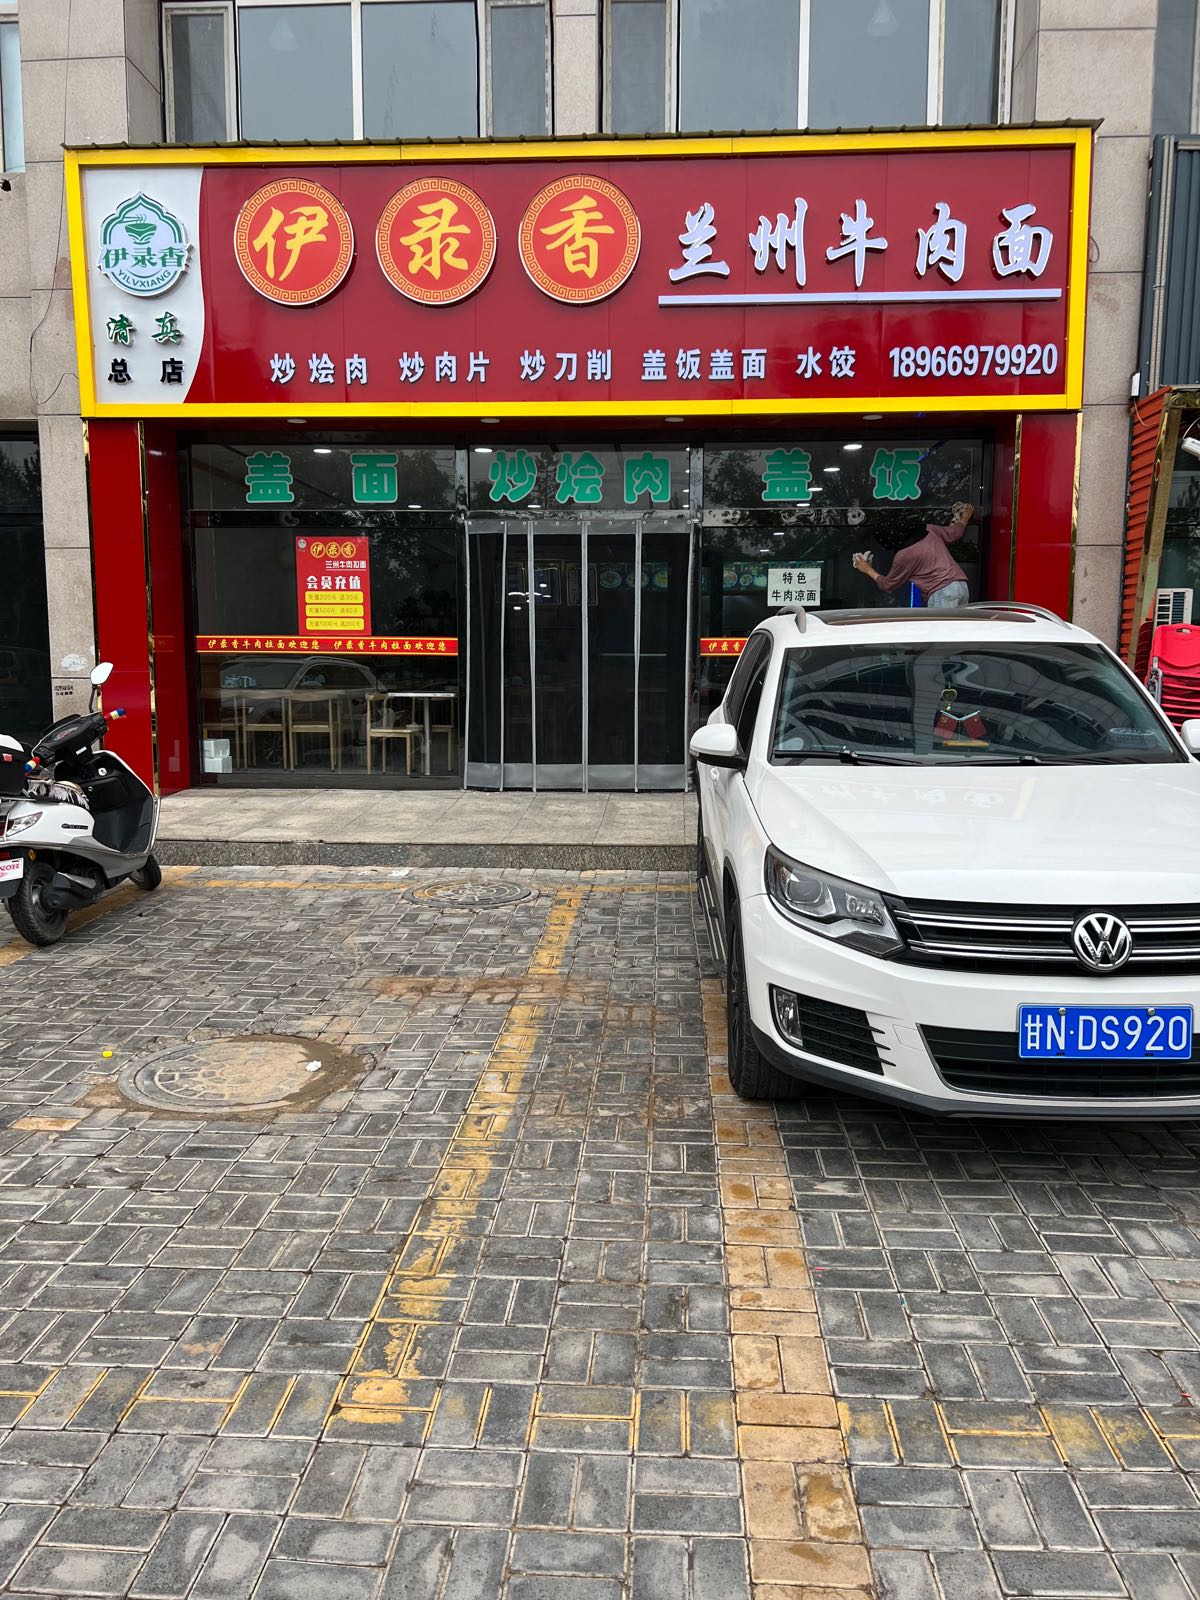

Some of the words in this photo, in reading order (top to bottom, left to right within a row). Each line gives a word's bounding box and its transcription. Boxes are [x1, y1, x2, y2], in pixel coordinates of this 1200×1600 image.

[252, 195, 616, 281] 伊录香
[669, 197, 1054, 287] 兰州牛肉面
[102, 246, 185, 268] 伊录香
[117, 269, 172, 288] YILVXIANG
[105, 312, 184, 344] 清真
[108, 358, 183, 384] 总店
[269, 353, 368, 385] 炒烩肉
[398, 351, 491, 383] 炒肉片
[519, 349, 612, 381] 炒刀削
[641, 348, 767, 380] 盖饭盖面
[796, 346, 856, 378] 水饺
[889, 343, 1058, 377] 18966979920
[245, 451, 399, 504] 盖面
[488, 449, 671, 504] 炒烩肉
[762, 447, 923, 501] 盖饭
[306, 575, 361, 590] 会员充值
[782, 572, 807, 585] 特色
[771, 589, 817, 602] 牛肉凉面
